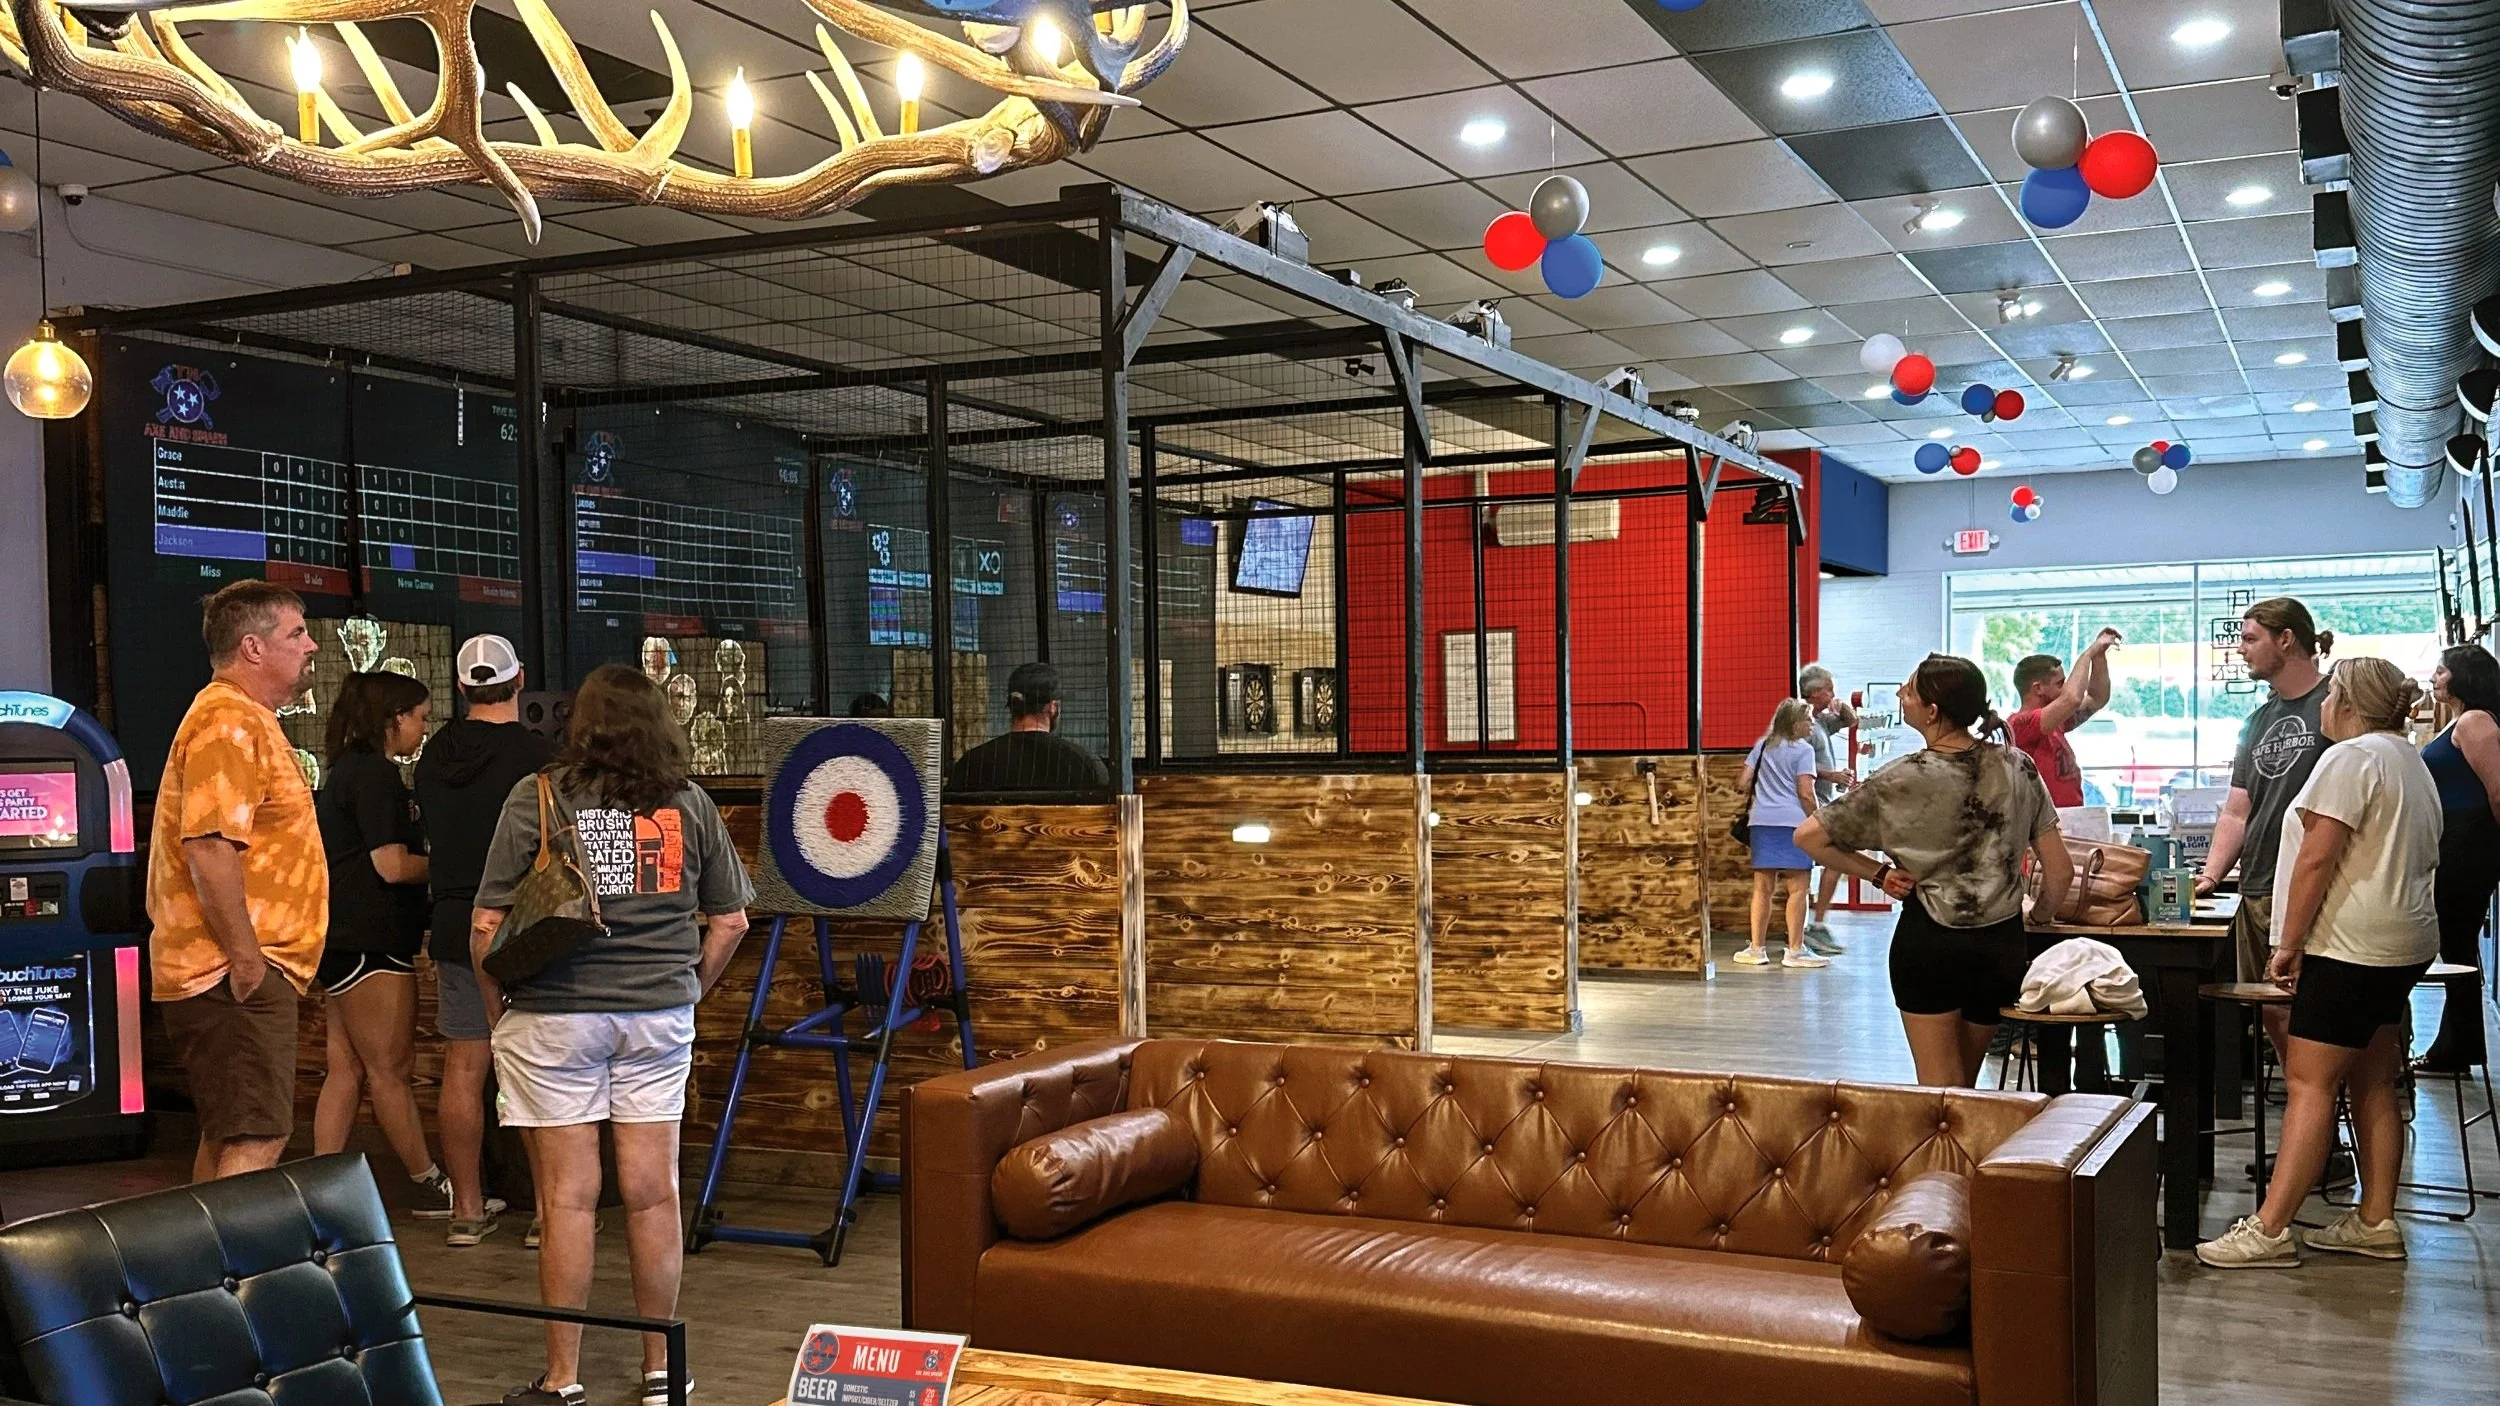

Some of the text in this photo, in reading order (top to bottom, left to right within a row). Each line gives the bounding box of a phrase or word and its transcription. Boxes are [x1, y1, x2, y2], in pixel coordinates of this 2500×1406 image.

[157, 447, 182, 461] Grace
[157, 476, 186, 490] Austin
[157, 505, 190, 519] Maddie
[158, 533, 193, 548] Jackson
[1960, 531, 1985, 551] EXIT
[200, 565, 221, 578] Miss
[414, 579, 434, 590] Game
[2252, 743, 2272, 759] SAFE
[2273, 735, 2316, 753] HARBOR
[7, 788, 26, 798] GET
[5, 797, 35, 807] PARTY
[0, 806, 48, 820] ARTED
[575, 808, 632, 820] HISTORIC
[577, 818, 632, 831] BRUSHY
[584, 840, 611, 850] TATE
[2183, 841, 2210, 849] LIGHT
[2186, 835, 2206, 843] BUD
[601, 872, 635, 884] HOUR
[597, 884, 635, 895] CURITY
[13, 987, 33, 995] THE
[34, 985, 59, 994] JUKE
[852, 1345, 902, 1373] MENU
[797, 1376, 838, 1402] BEER
[842, 1383, 869, 1394] DOMESTIC
